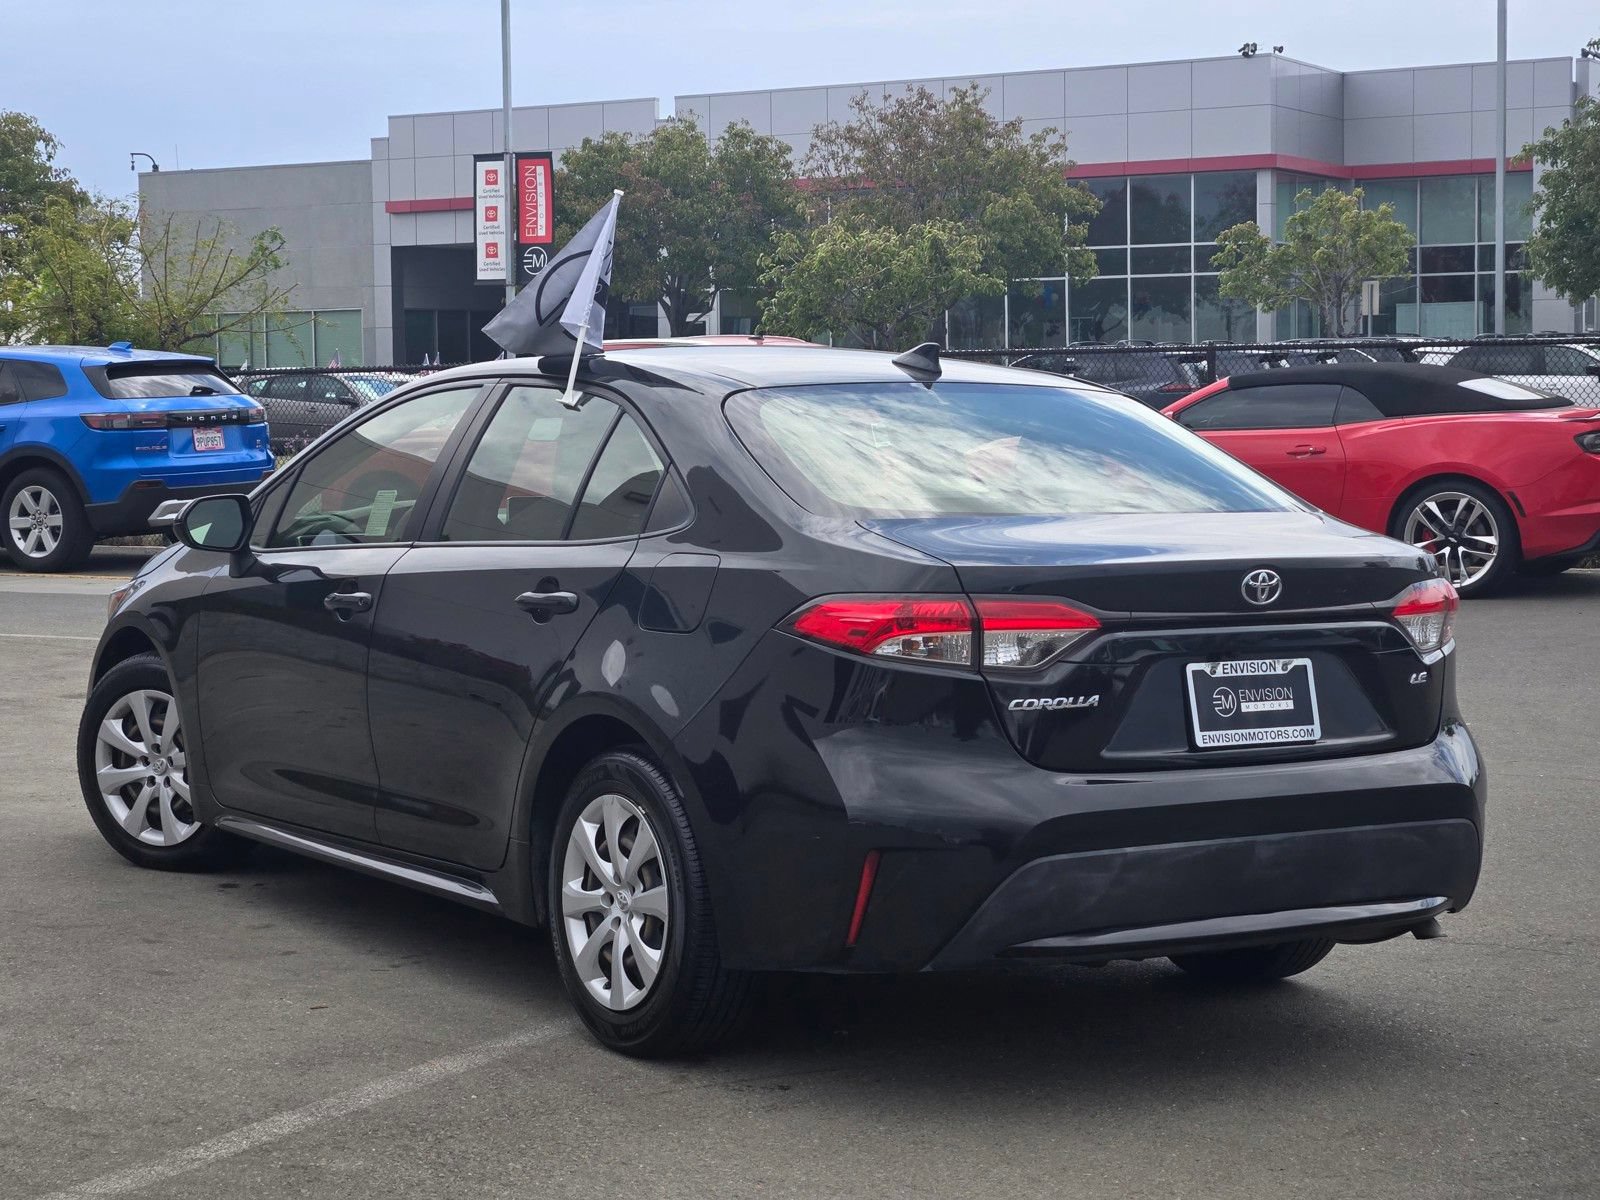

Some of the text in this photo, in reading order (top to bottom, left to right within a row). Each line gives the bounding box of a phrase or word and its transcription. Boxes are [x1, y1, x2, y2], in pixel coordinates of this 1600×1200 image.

[525, 165, 537, 237] ENVISION
[1222, 661, 1277, 675] ENVISION
[1410, 671, 1428, 684] LE
[1238, 687, 1293, 702] ENVISION
[1008, 694, 1100, 711] COROLLA
[1245, 702, 1290, 710] MOTORS
[1201, 728, 1315, 745] ENVISIONMOTORS.COM
